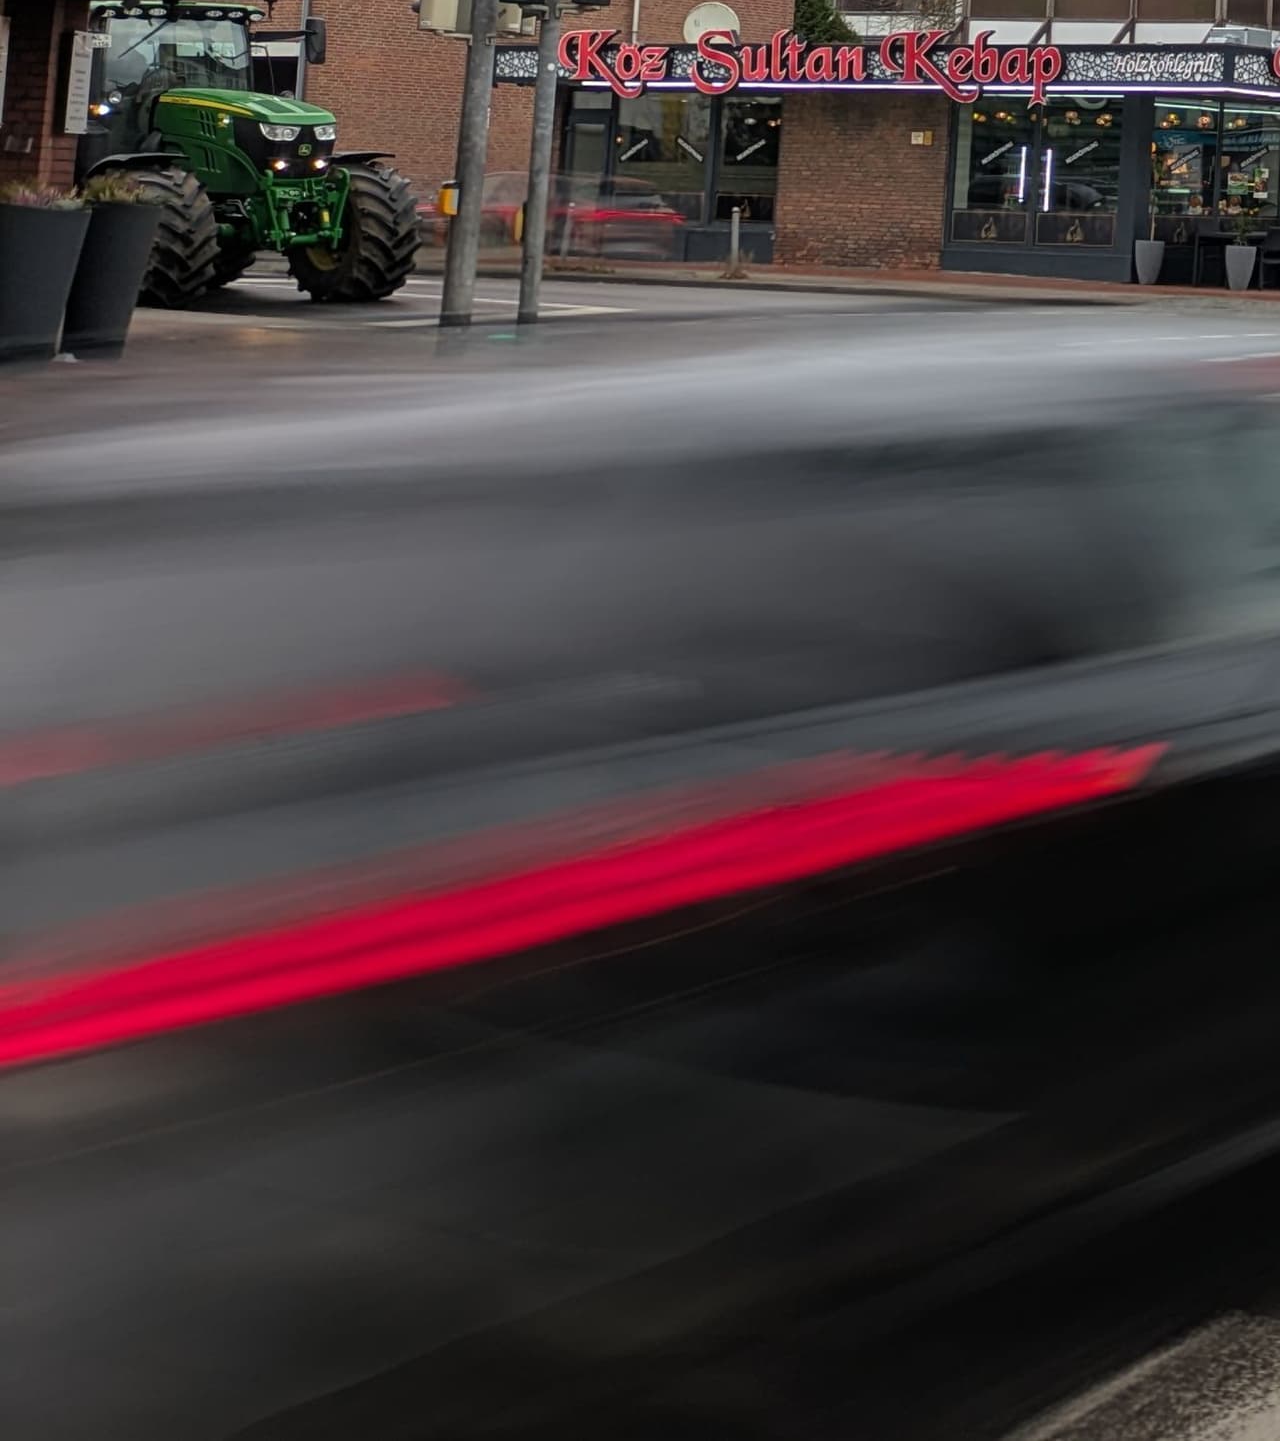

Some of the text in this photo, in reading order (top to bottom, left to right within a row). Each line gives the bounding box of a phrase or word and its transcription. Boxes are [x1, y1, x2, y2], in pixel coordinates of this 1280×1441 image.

[558, 29, 1063, 109] Köz Sultan Kebap
[1112, 52, 1221, 80] Holzkohlegrill
